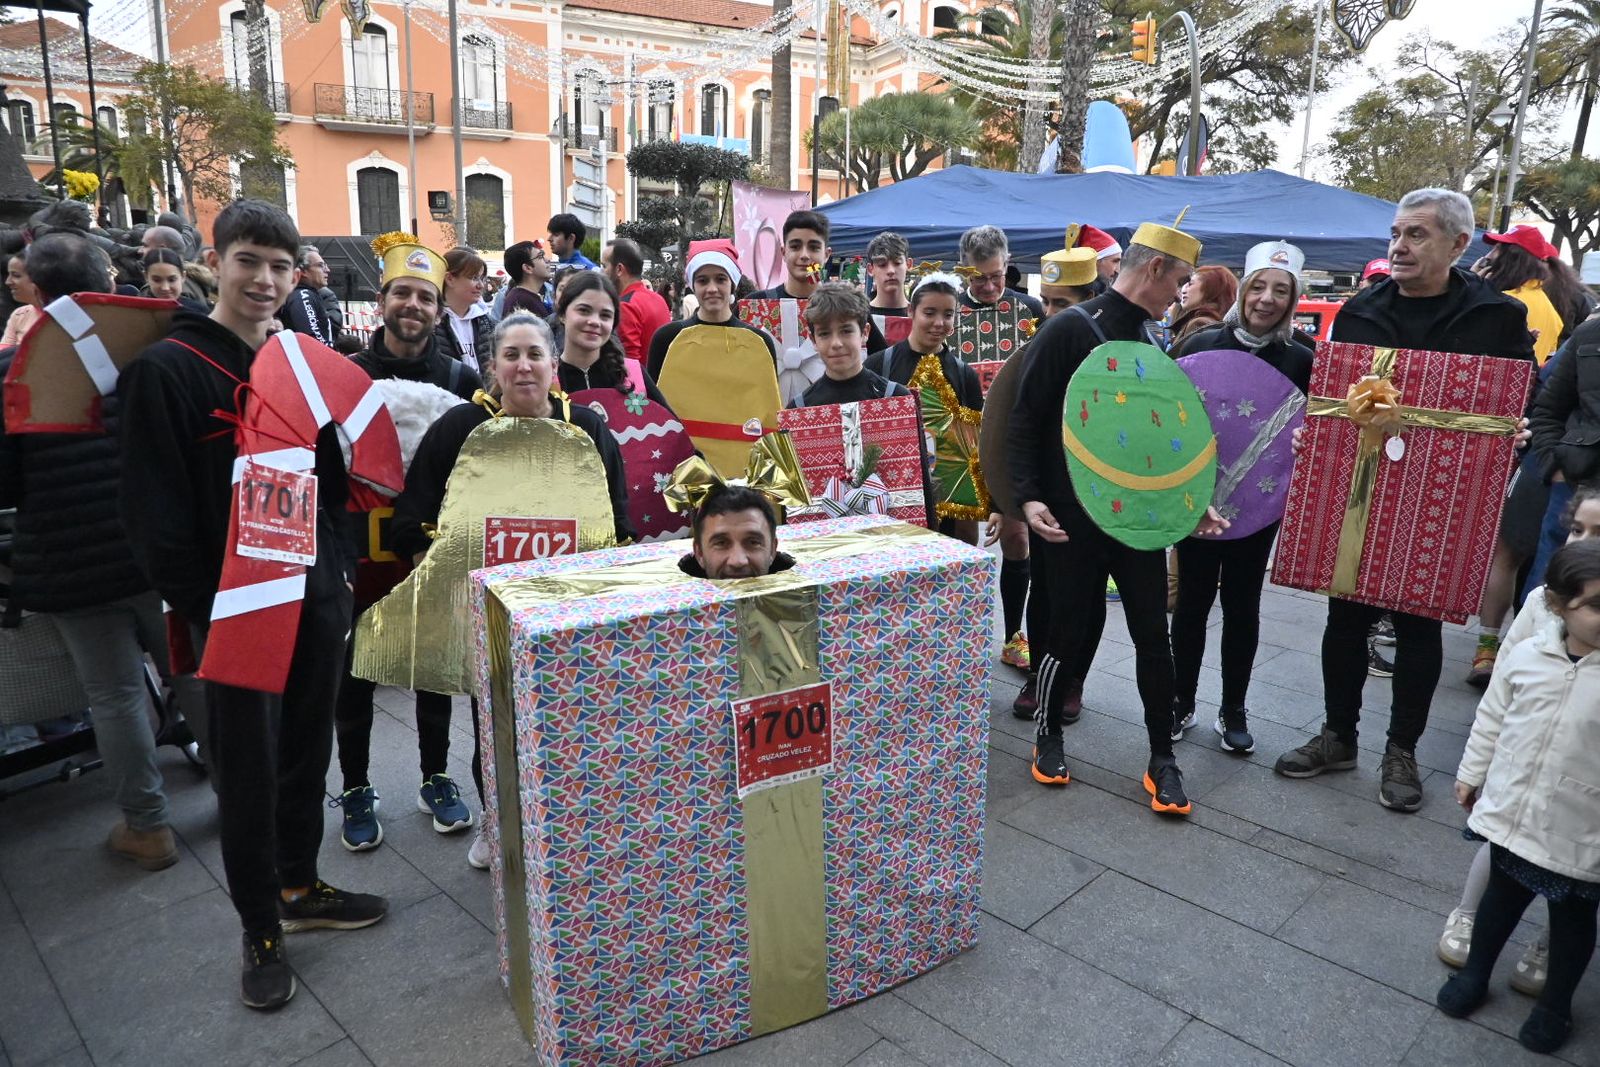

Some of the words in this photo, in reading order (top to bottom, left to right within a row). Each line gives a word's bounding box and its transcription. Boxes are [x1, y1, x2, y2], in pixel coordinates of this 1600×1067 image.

[300, 289, 310, 299] LA
[245, 480, 308, 521] 1701
[246, 521, 279, 533] FRANCISCO
[279, 526, 306, 537] CASTILLO
[491, 531, 571, 559] 1702
[743, 702, 826, 749] 1700
[757, 751, 790, 762] CRUZADO
[791, 745, 812, 755] VELEZ
[778, 742, 792, 750] IVAN
